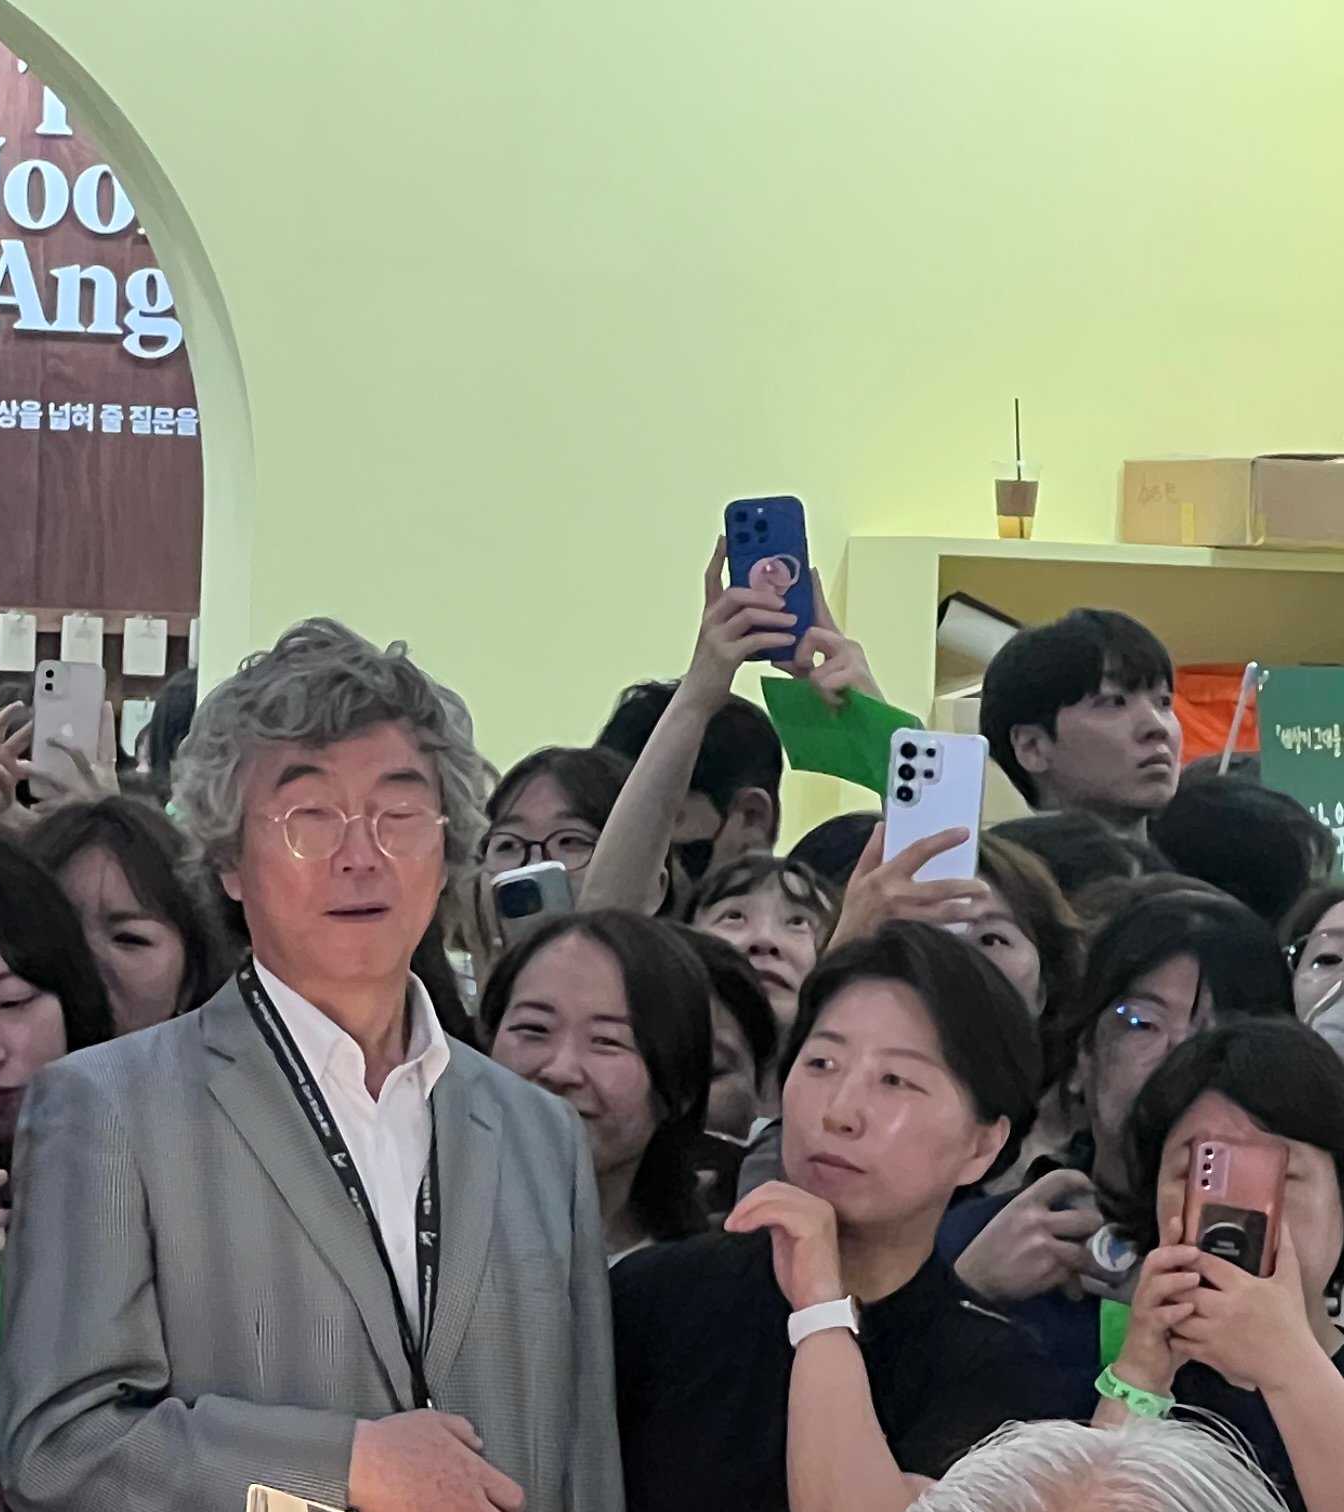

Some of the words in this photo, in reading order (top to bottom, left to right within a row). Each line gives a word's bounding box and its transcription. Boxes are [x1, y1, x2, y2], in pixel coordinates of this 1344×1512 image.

[48, 402, 94, 432] 넓혀
[100, 404, 123, 434] 줄
[129, 405, 199, 437] 질문을
